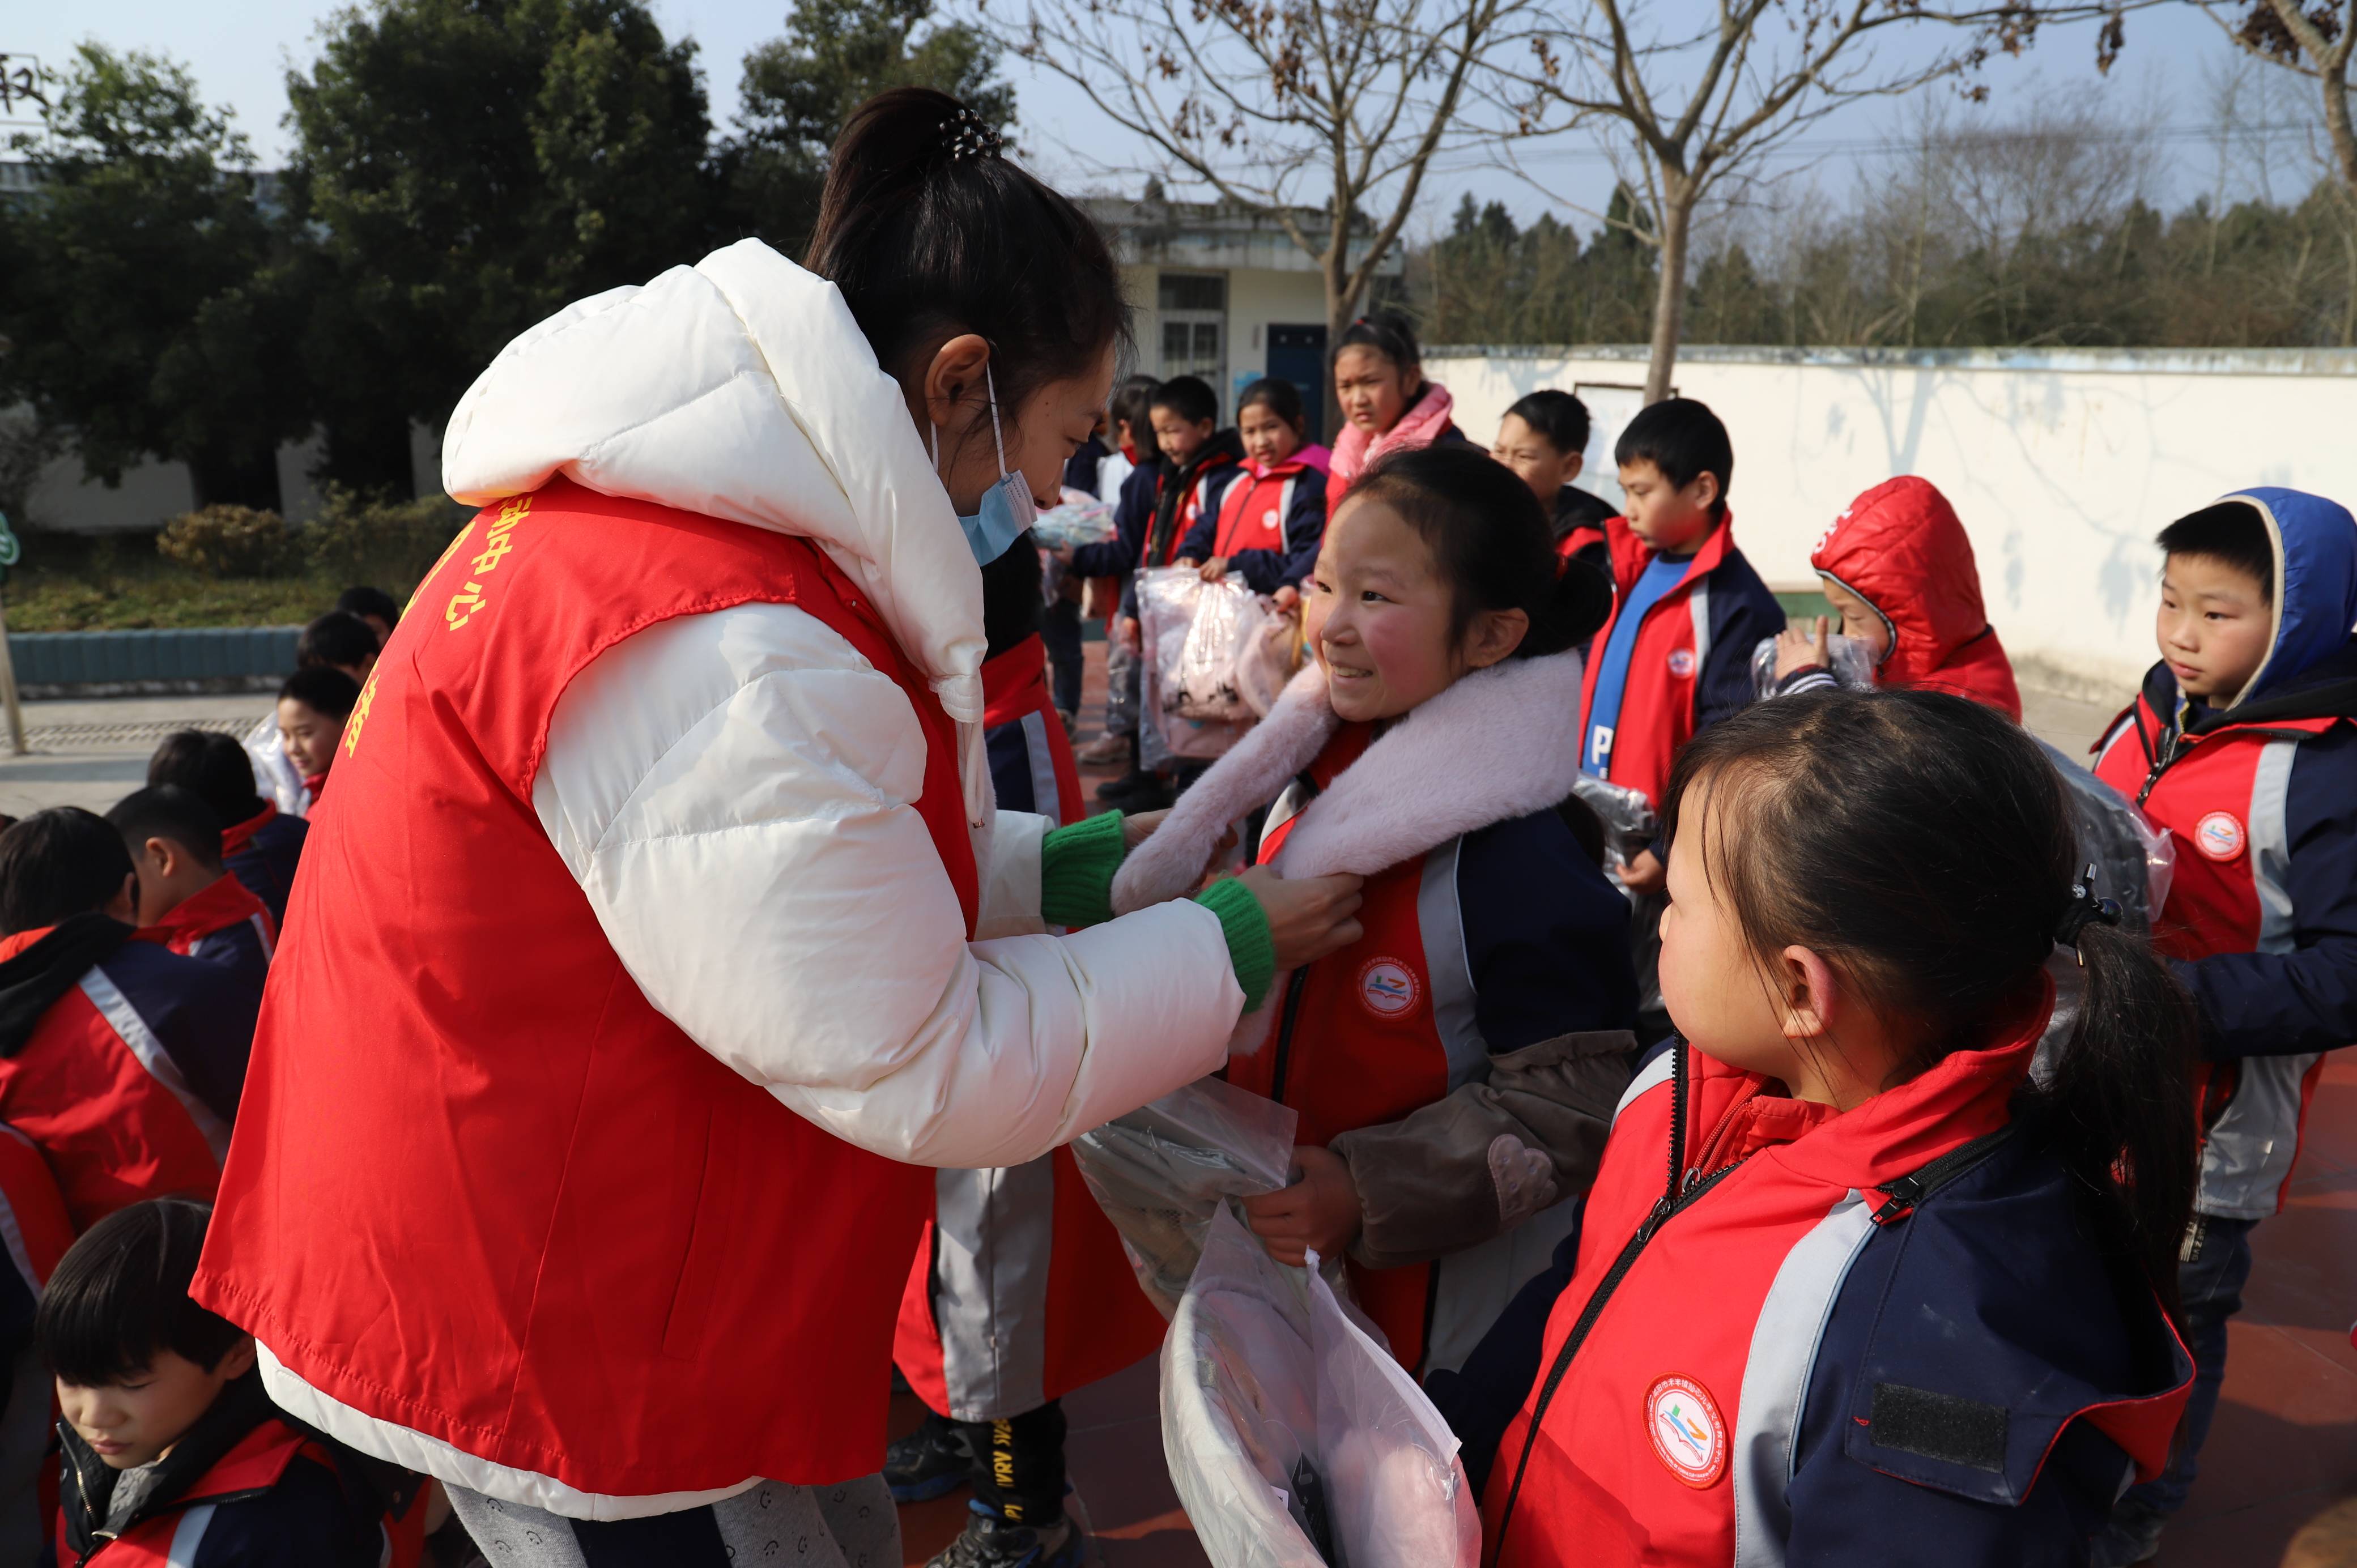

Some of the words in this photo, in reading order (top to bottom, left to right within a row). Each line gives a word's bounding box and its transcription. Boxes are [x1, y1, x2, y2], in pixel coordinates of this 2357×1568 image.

[445, 495, 533, 632] 动中心
[344, 657, 380, 759] 者
